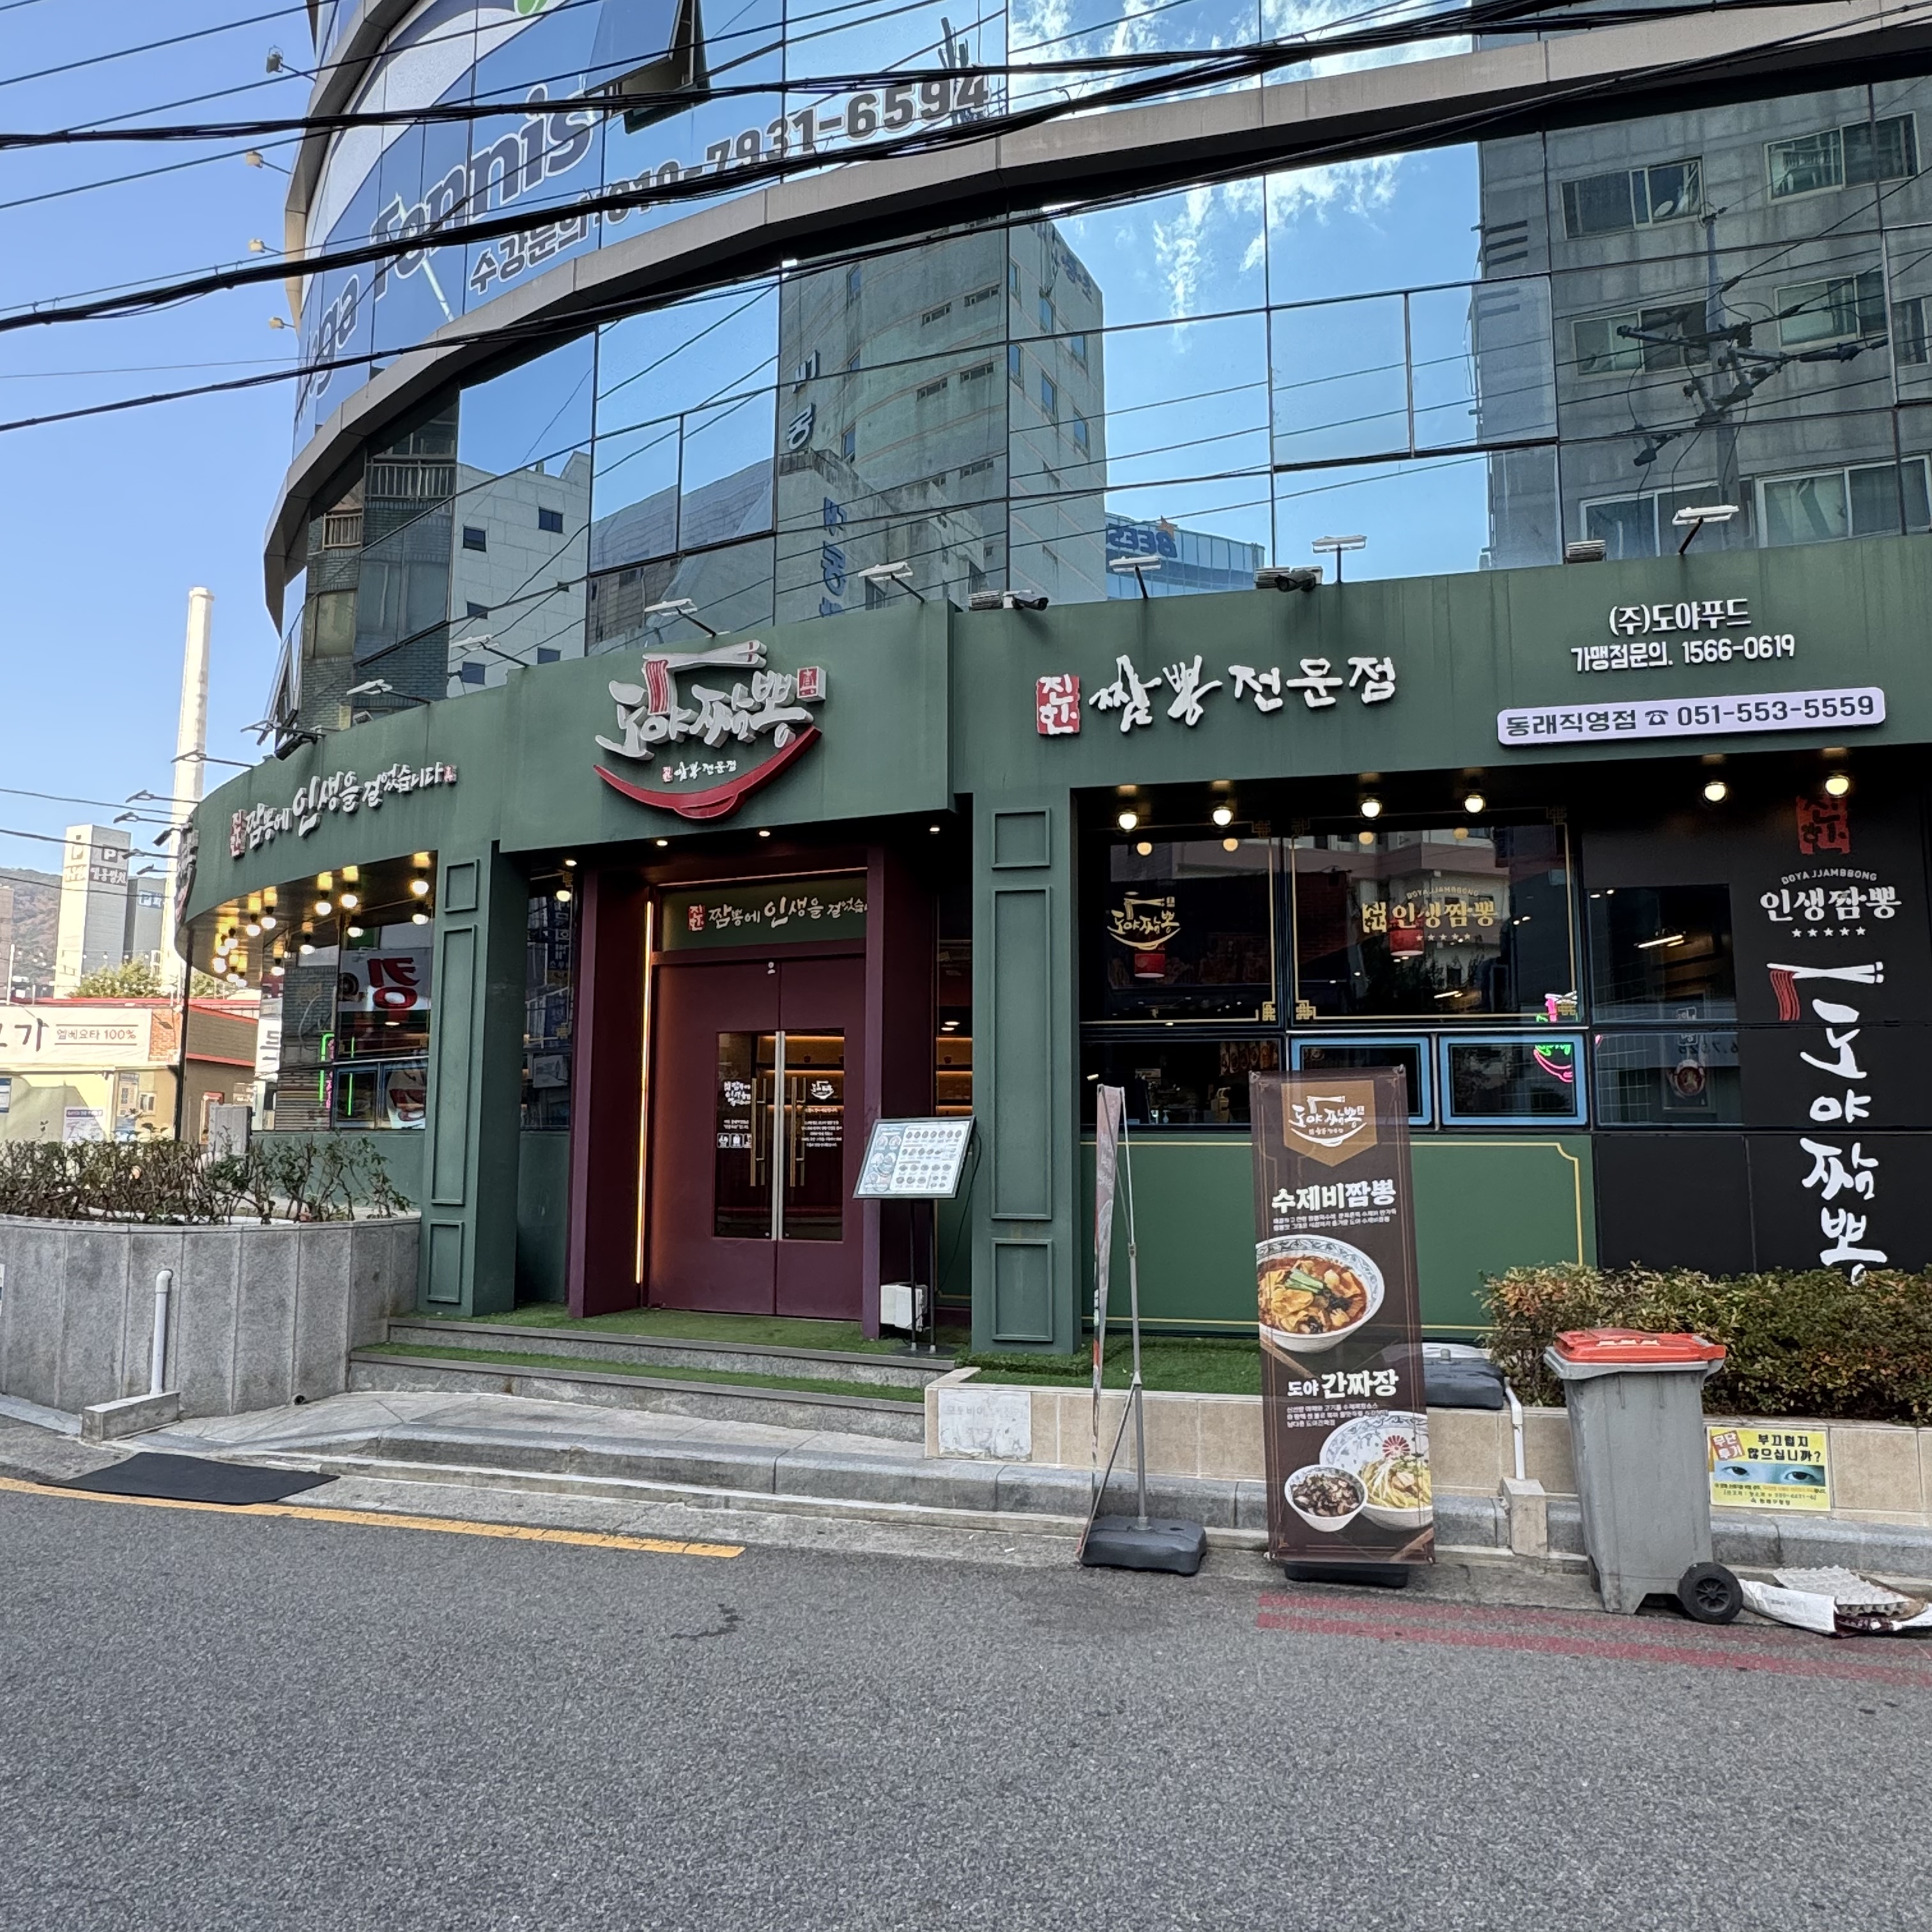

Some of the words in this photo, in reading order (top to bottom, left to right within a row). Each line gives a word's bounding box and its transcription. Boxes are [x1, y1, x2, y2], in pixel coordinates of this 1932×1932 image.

[1609, 598, 1752, 636] (주)도야푸드
[1682, 634, 1795, 664] 1566-0619
[1506, 710, 1637, 737] 동래직영점
[1677, 694, 1874, 727] 051-553-5559
[293, 770, 362, 836] 인생을
[1781, 871, 1810, 885] DOYA
[1811, 868, 1877, 881] JJAMBBONG
[708, 903, 760, 929] 짬뽕에
[764, 896, 824, 929] 인생을
[1392, 900, 1498, 929] 인생짬뽕
[1759, 885, 1903, 922] 인생짬뽕
[104, 1029, 137, 1040] 100%
[1271, 1179, 1397, 1214] 수제비짬뽕
[1287, 1381, 1319, 1398] 도야
[1321, 1368, 1399, 1399] 간짜장
